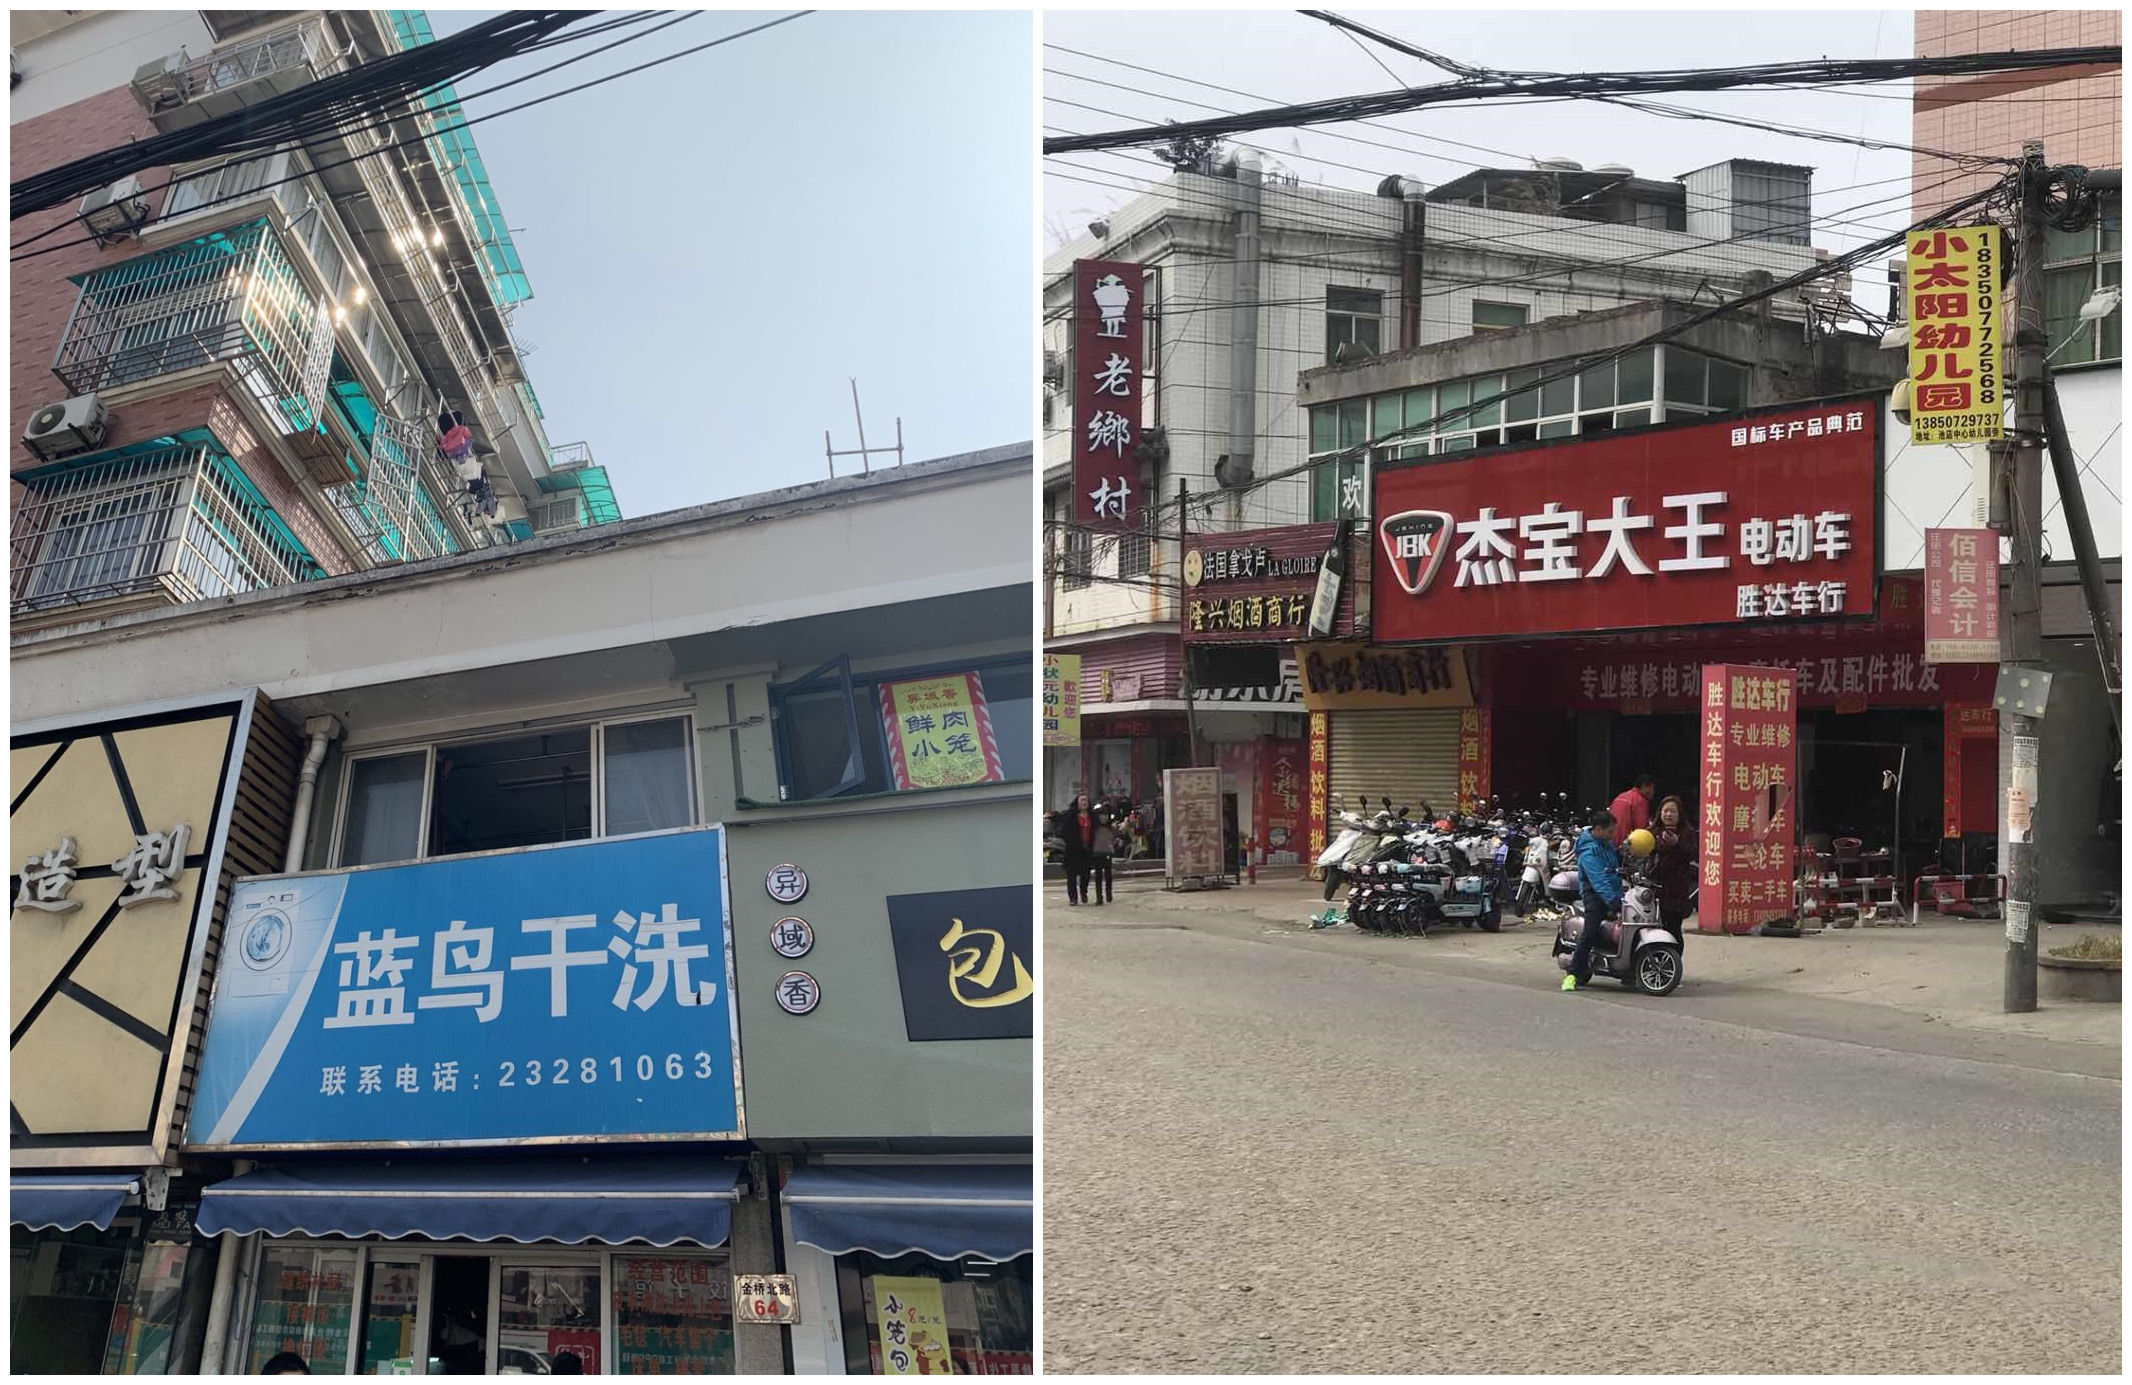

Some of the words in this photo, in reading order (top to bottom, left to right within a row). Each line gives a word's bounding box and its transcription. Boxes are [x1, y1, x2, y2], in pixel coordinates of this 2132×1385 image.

[1911, 231, 1973, 412] 小太阳幼儿园
[1976, 232, 1996, 404] 18350772568
[1087, 352, 1134, 521] 老鄉村
[1730, 411, 1865, 447] 国标车产品典范
[1915, 413, 1999, 430] 13850729737
[1395, 532, 1433, 559] JBK
[1453, 490, 1731, 588] 杰宝大王
[1739, 510, 1853, 567] 电动车
[1267, 561, 1280, 577] LA
[1281, 555, 1317, 576] GLOIRE
[1948, 531, 1980, 636] 佰信会计
[1188, 598, 1306, 632] 隆兴烟酒商行
[1735, 580, 1847, 619] 胜达车行
[1730, 676, 1791, 713] 胜达车行
[905, 711, 970, 735] 鲜肉
[1730, 722, 1792, 748] 专业维修
[911, 732, 977, 758] 小笼
[1704, 681, 1724, 887] 胜达车行欢迎您
[1733, 762, 1787, 792] 电动车
[1732, 805, 1786, 833] 摩车
[13, 823, 192, 914] 造型
[1732, 842, 1786, 871] 三轮车
[1728, 879, 1788, 903] 买卖二手车
[774, 869, 812, 1006] 异域香
[321, 903, 717, 1030] 蓝鸟干洗
[938, 917, 1034, 1009] 包
[176, 1220, 191, 1229] FA
[627, 1257, 709, 1285] 经营范围
[741, 1282, 792, 1296] 金桥北路
[754, 1300, 780, 1317] 64
[884, 1294, 909, 1372] 小笼包
